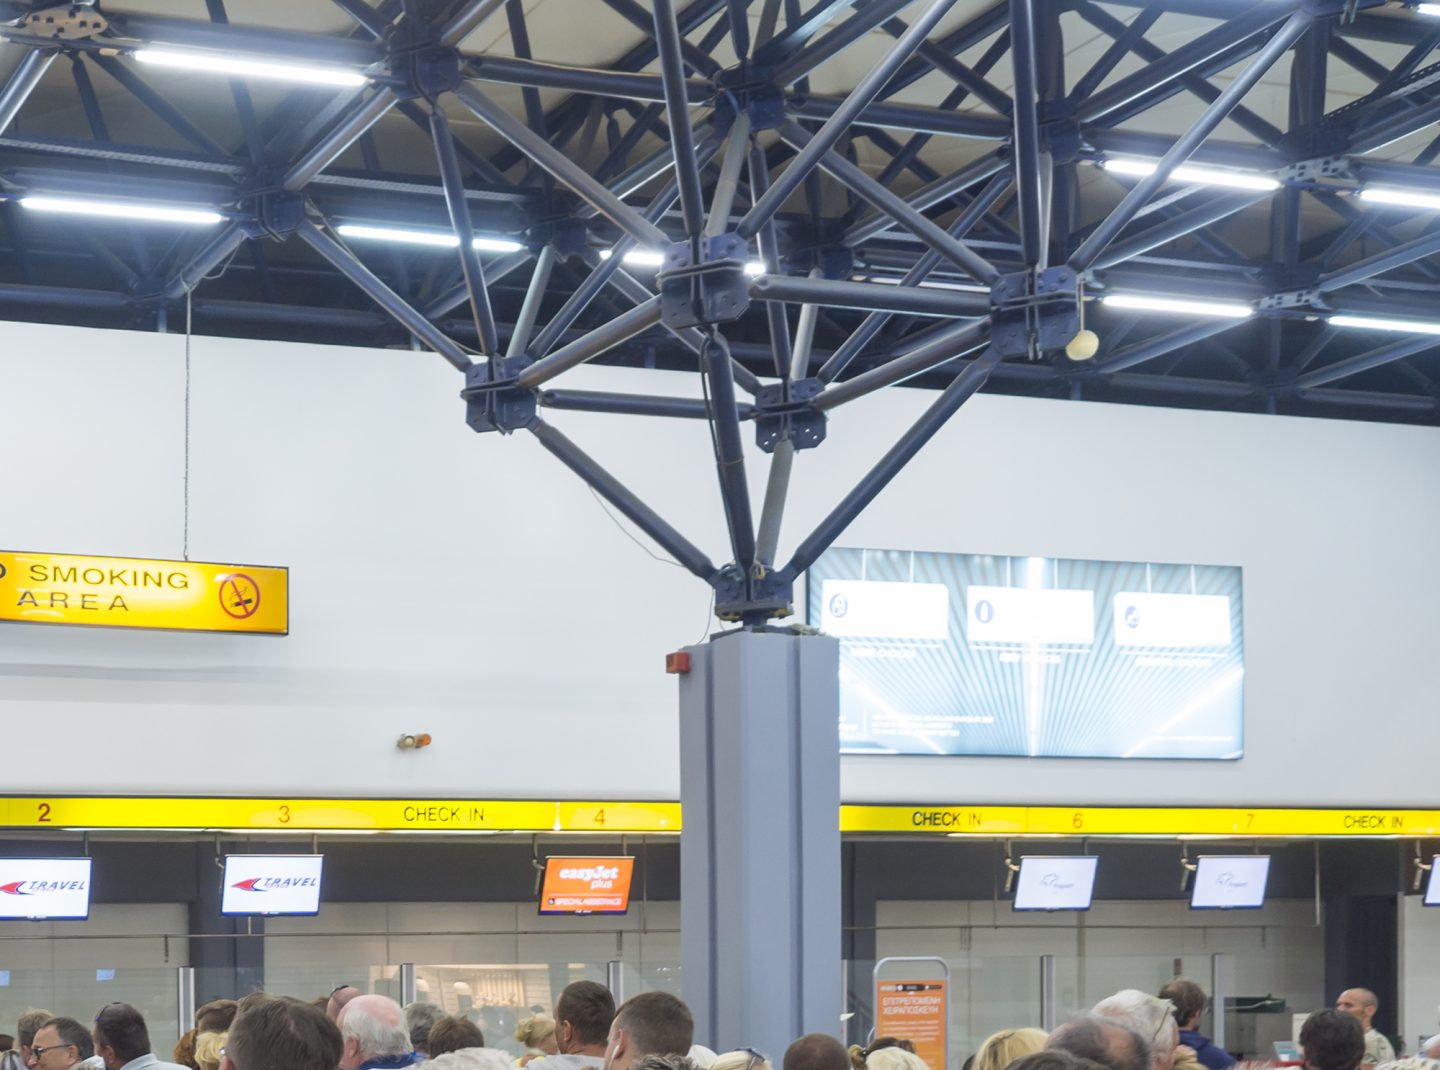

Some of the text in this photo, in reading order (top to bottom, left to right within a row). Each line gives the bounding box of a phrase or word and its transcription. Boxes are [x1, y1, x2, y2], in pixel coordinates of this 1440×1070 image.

[29, 564, 189, 590] SMOKING
[16, 590, 130, 612] AREA
[37, 802, 51, 822] 2
[277, 805, 291, 824] 3
[403, 805, 484, 822] CHECK IN
[593, 808, 606, 825] 4
[912, 811, 982, 826] CHECK IN
[1072, 812, 1083, 829] 6
[1246, 813, 1255, 829] 7
[1343, 815, 1404, 829] CHECK IN
[264, 877, 317, 887] TRAVEL
[559, 865, 619, 882] easyJet
[28, 880, 86, 890] TRAVEL
[590, 878, 613, 890] plus
